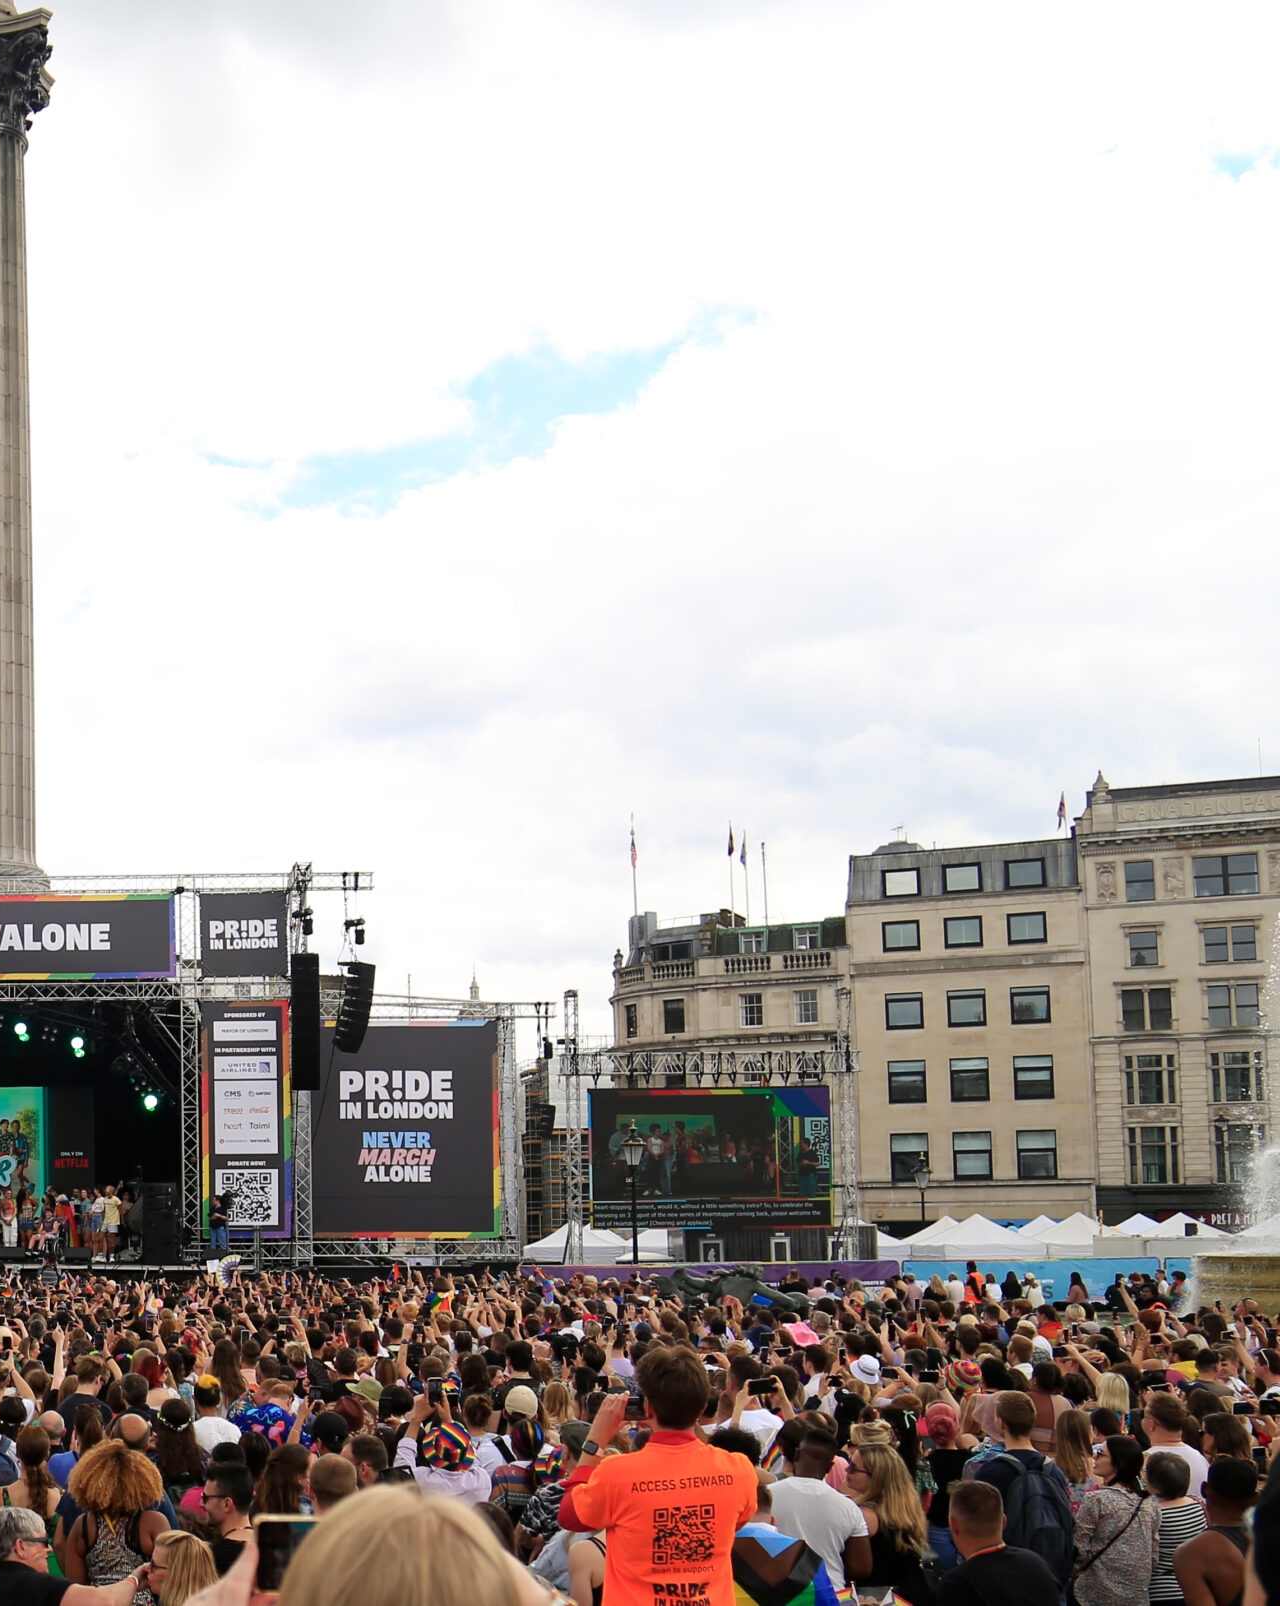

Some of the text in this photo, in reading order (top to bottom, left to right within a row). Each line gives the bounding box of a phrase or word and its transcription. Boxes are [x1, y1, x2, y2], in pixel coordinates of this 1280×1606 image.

[1120, 797, 1231, 822] CANADIAN
[210, 937, 278, 950] IN LONDON
[340, 1101, 453, 1119] IN LONDON
[362, 1132, 431, 1148] NEVER
[55, 1159, 88, 1168] NETFLIX
[358, 1149, 436, 1165] MARCH
[364, 1165, 431, 1182] ALONE
[1211, 1213, 1232, 1224] PRET
[1235, 1213, 1240, 1224] A
[631, 1475, 734, 1493] ACCESS STEWARD
[682, 1565, 714, 1573] support
[654, 1598, 666, 1606] IN
